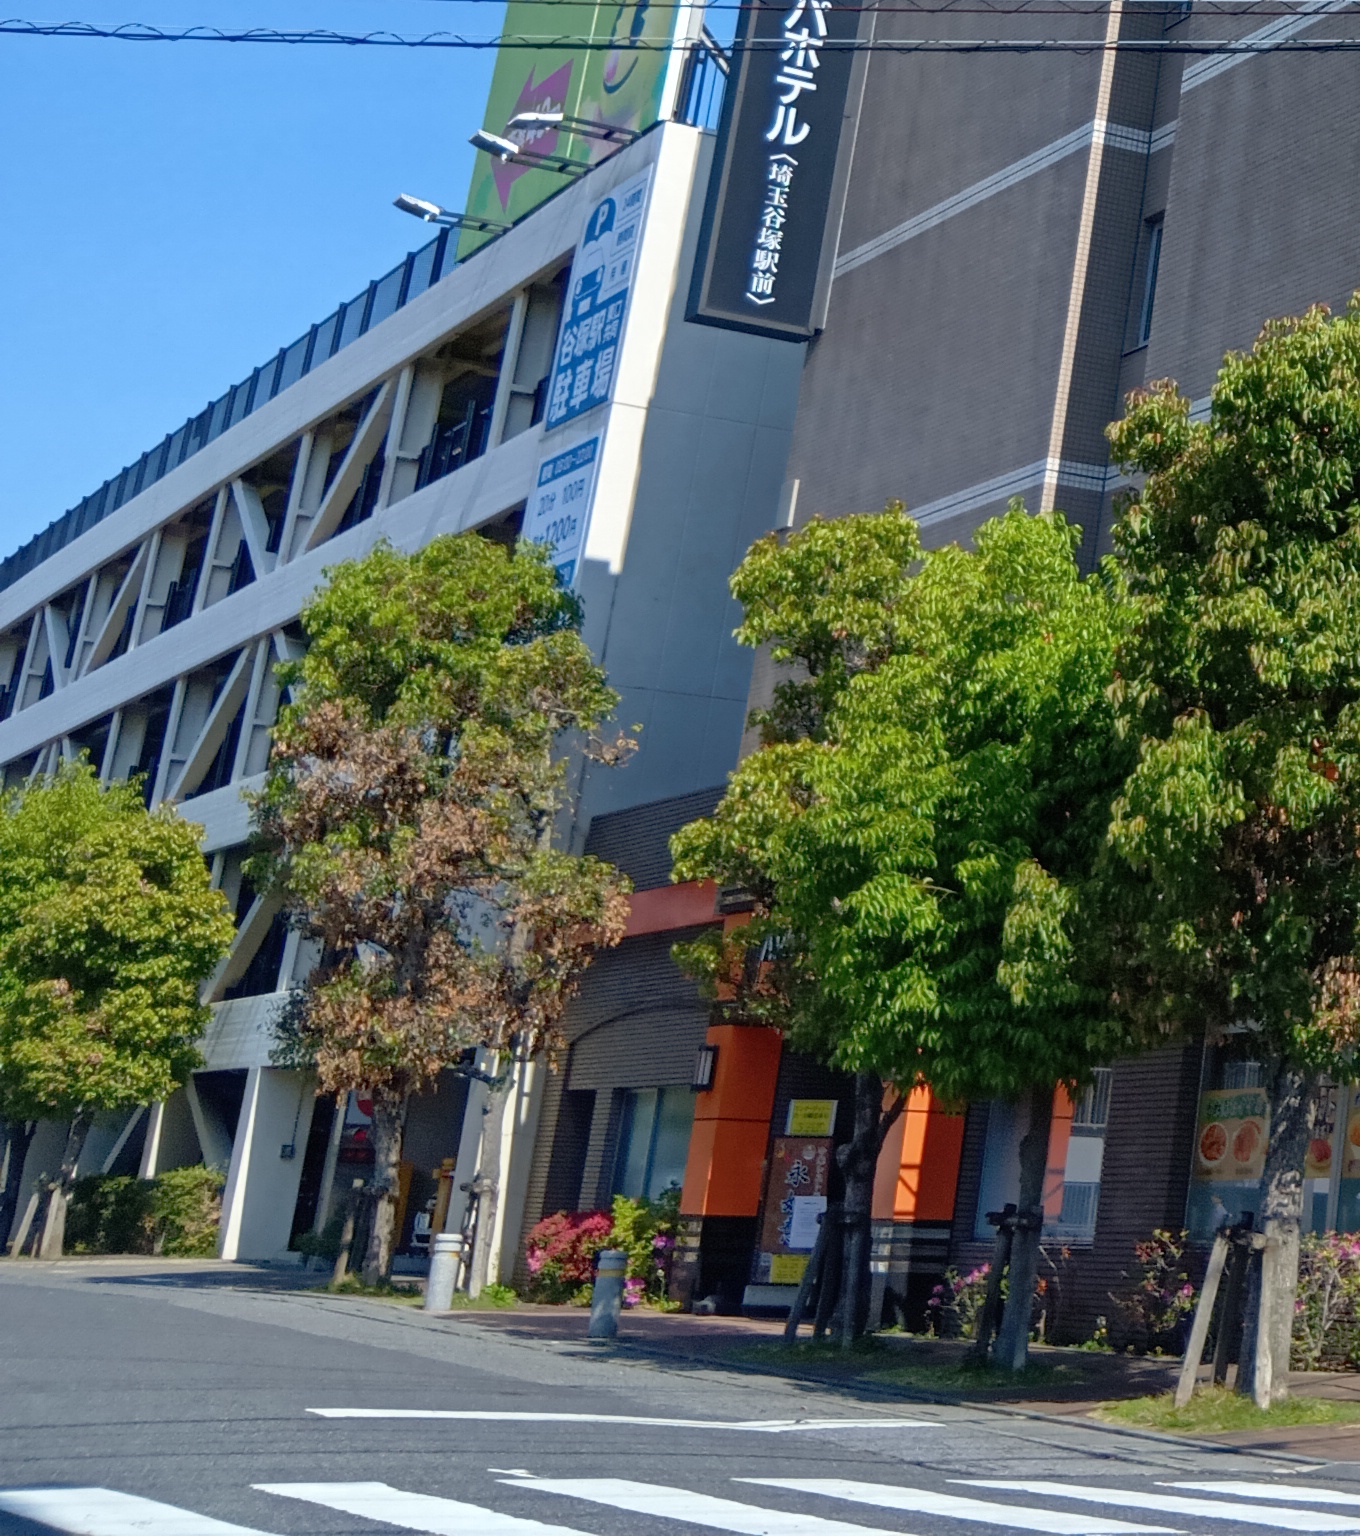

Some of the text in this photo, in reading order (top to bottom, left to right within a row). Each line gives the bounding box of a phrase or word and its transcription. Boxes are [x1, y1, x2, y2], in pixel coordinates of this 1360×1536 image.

[594, 202, 610, 237] P
[548, 345, 616, 423] 駐車場
